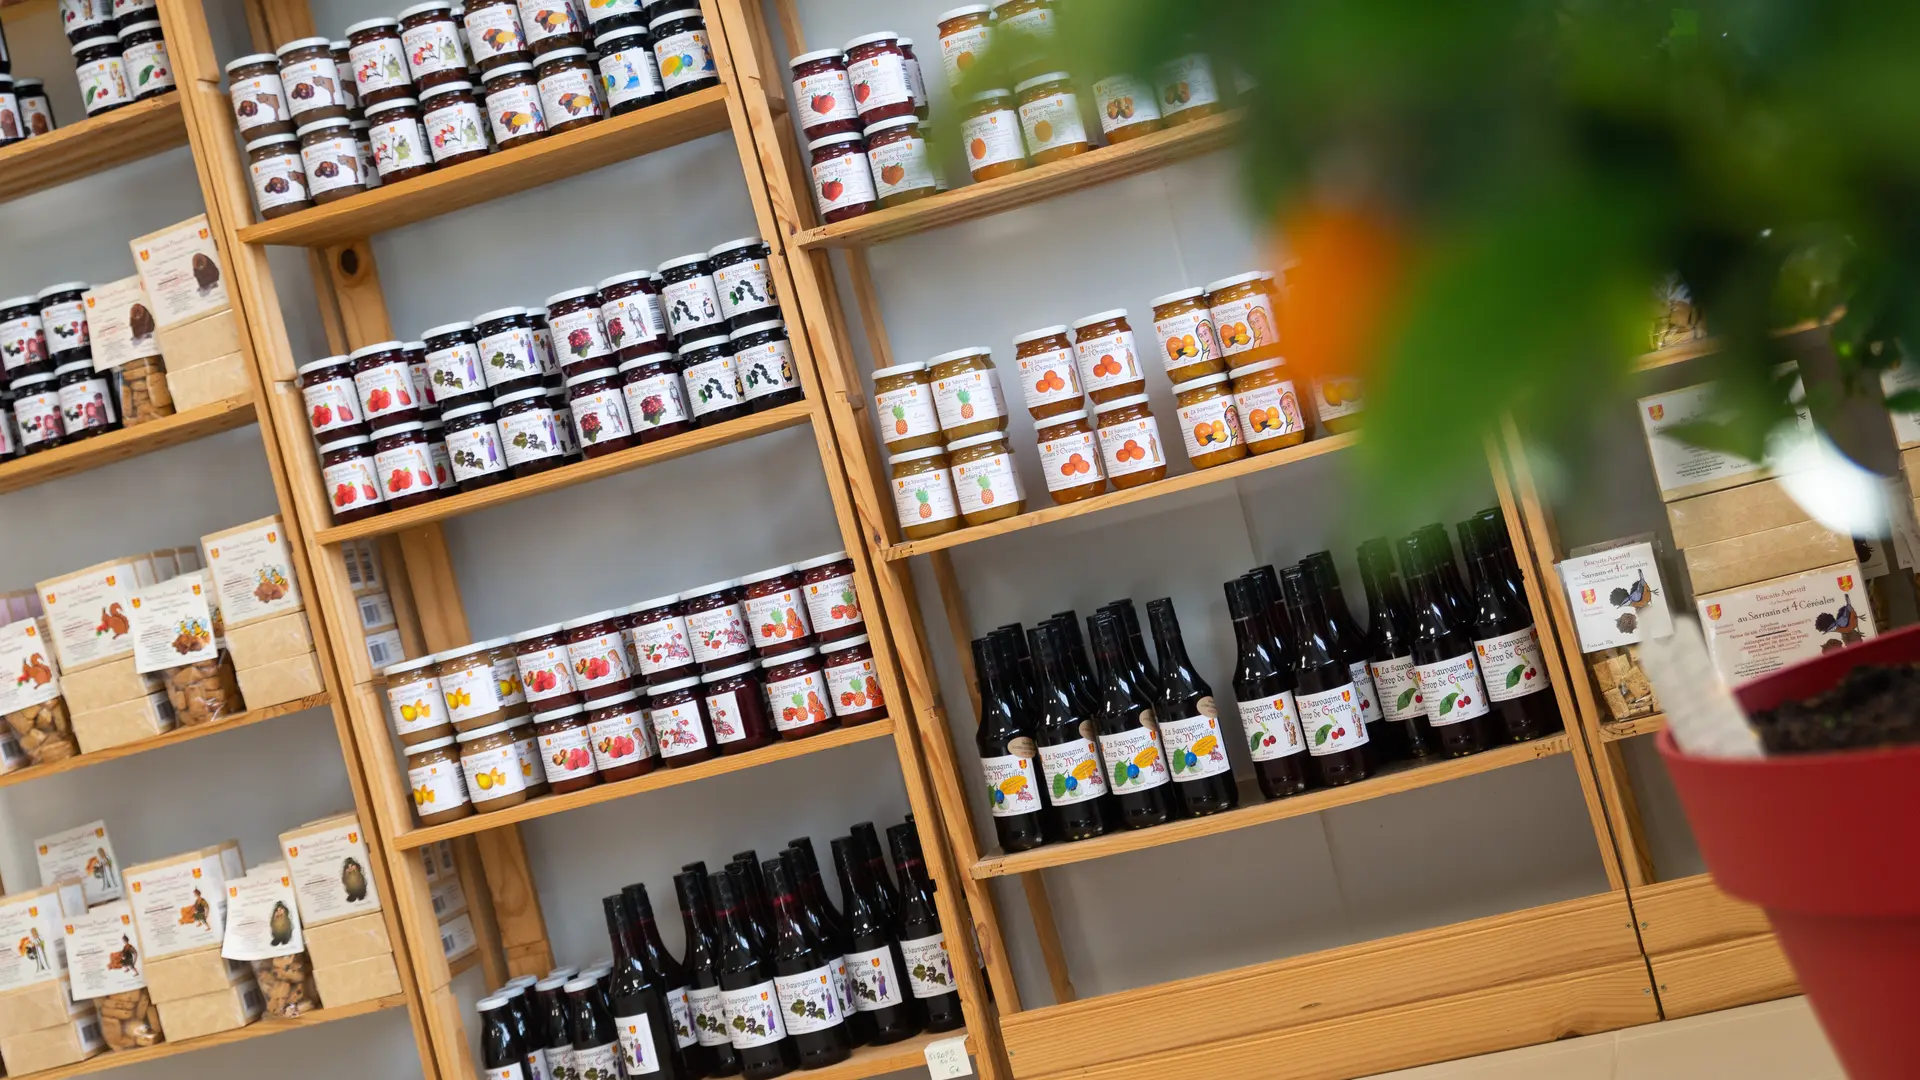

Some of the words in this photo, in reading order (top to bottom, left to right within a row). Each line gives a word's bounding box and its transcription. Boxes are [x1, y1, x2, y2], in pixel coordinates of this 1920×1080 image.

[1583, 557, 1607, 567] Biscuits
[1581, 570, 1607, 579] Sarrasin
[1755, 592, 1781, 602] Biscuits
[1738, 615, 1748, 624] au
[1748, 608, 1781, 621] Sarrasin
[1799, 596, 1835, 609] Céréales
[1488, 643, 1497, 653] La
[1498, 635, 1531, 650] Sauvagine
[1485, 653, 1504, 664] Sirop
[1432, 663, 1466, 678] Sauvagine
[1379, 676, 1396, 686] Sirop
[1422, 680, 1438, 690] Sirop
[1447, 671, 1475, 684] Griottes
[1308, 695, 1341, 708] Sauvagine
[1321, 703, 1351, 716] Griottes
[1254, 712, 1284, 723] Griottes
[1172, 723, 1204, 735] Sauvagine
[1114, 734, 1146, 747] Sauvagine
[1053, 747, 1084, 761] Sauvagine
[1064, 754, 1095, 767] Myrtilles
[786, 978, 818, 990] Sauvagine
